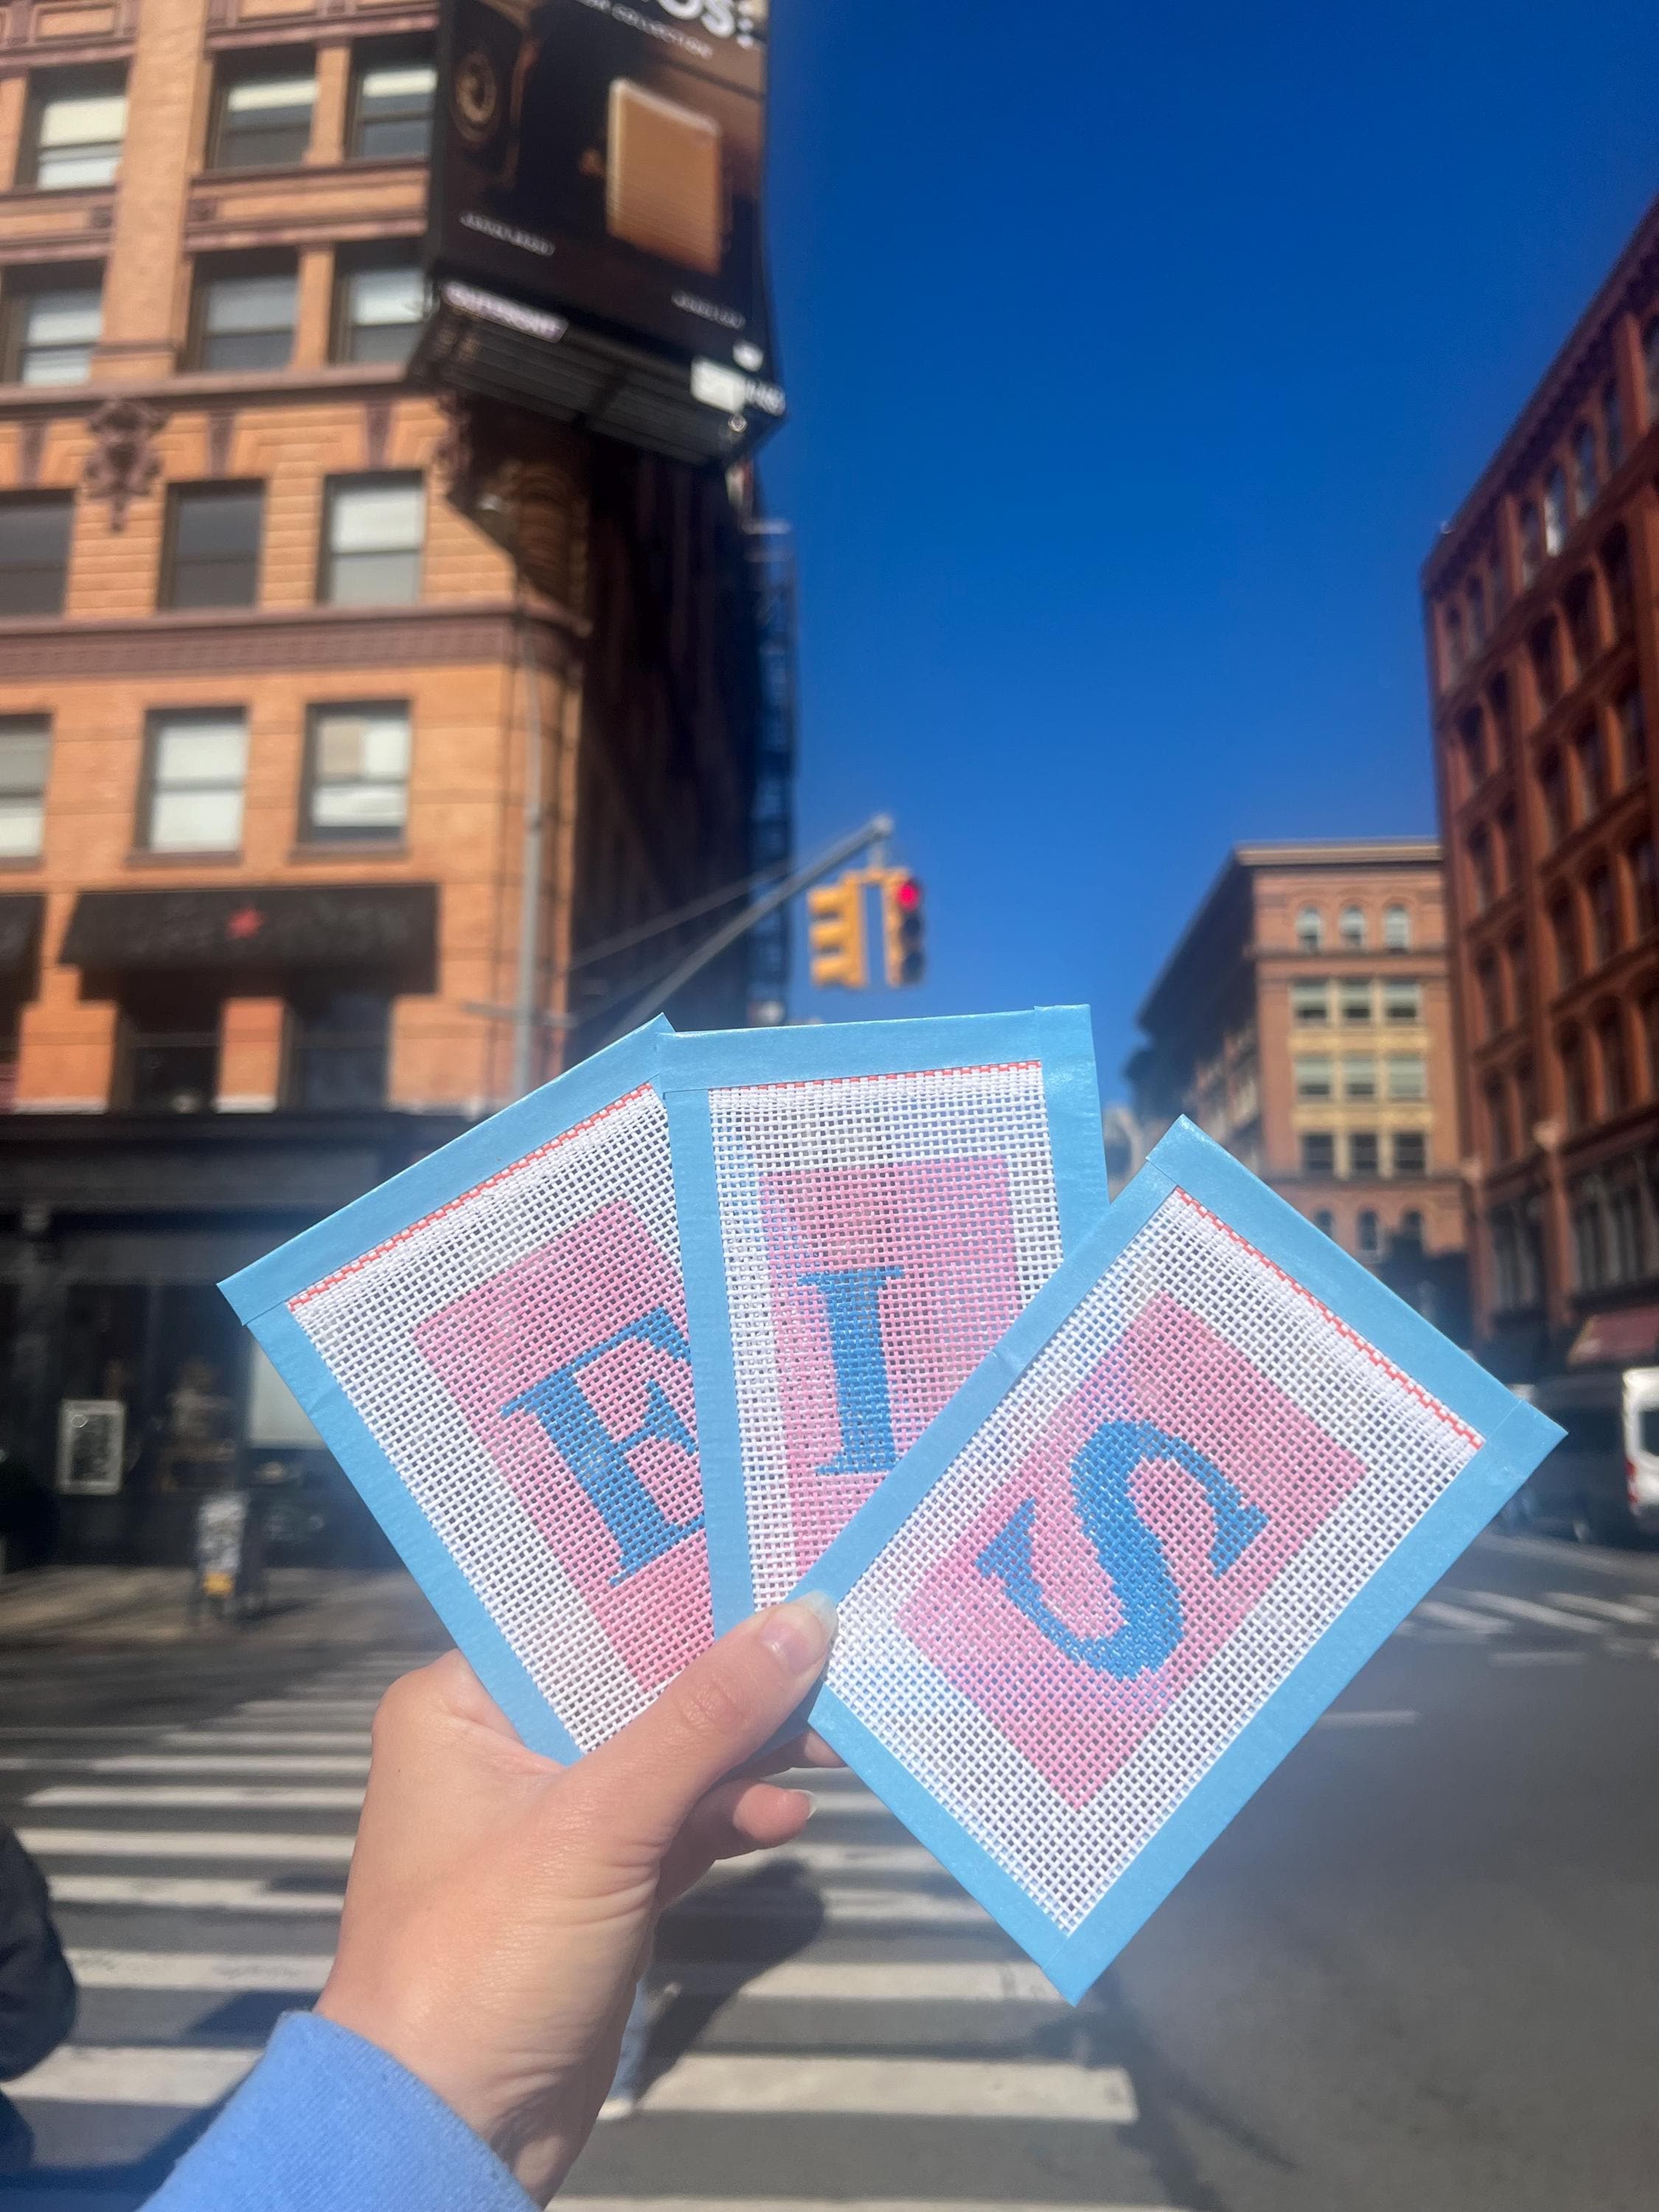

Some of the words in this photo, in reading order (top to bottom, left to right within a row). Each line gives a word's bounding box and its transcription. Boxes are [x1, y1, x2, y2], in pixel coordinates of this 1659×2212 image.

[501, 1307, 706, 1587] E
[799, 1267, 903, 1475] I
[976, 1420, 1269, 1678] S
